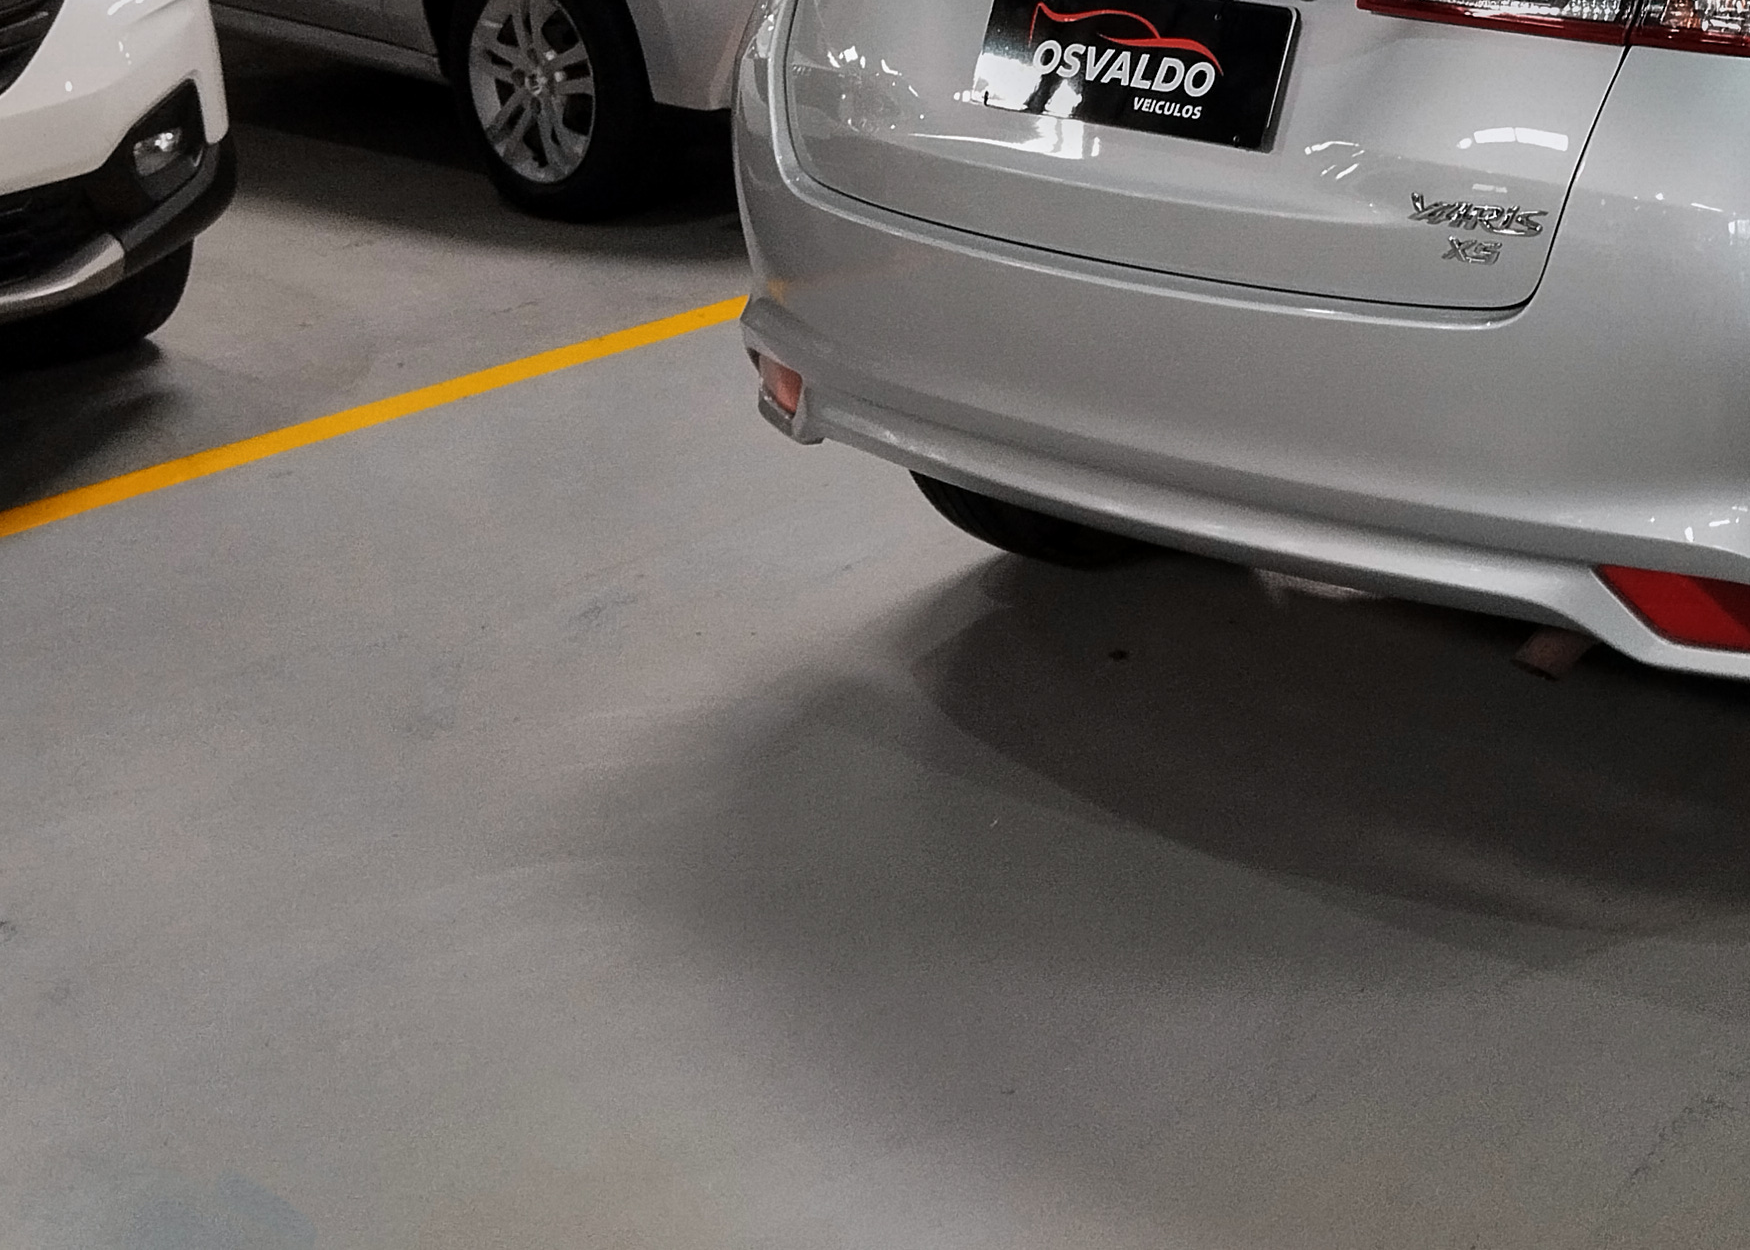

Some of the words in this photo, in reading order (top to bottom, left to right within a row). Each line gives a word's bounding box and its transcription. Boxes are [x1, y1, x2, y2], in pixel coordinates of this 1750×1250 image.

[1033, 40, 1215, 97] OSVALDO
[1133, 97, 1202, 119] VEICULOS
[1408, 192, 1549, 237] YARIS
[1441, 235, 1502, 265] XS
